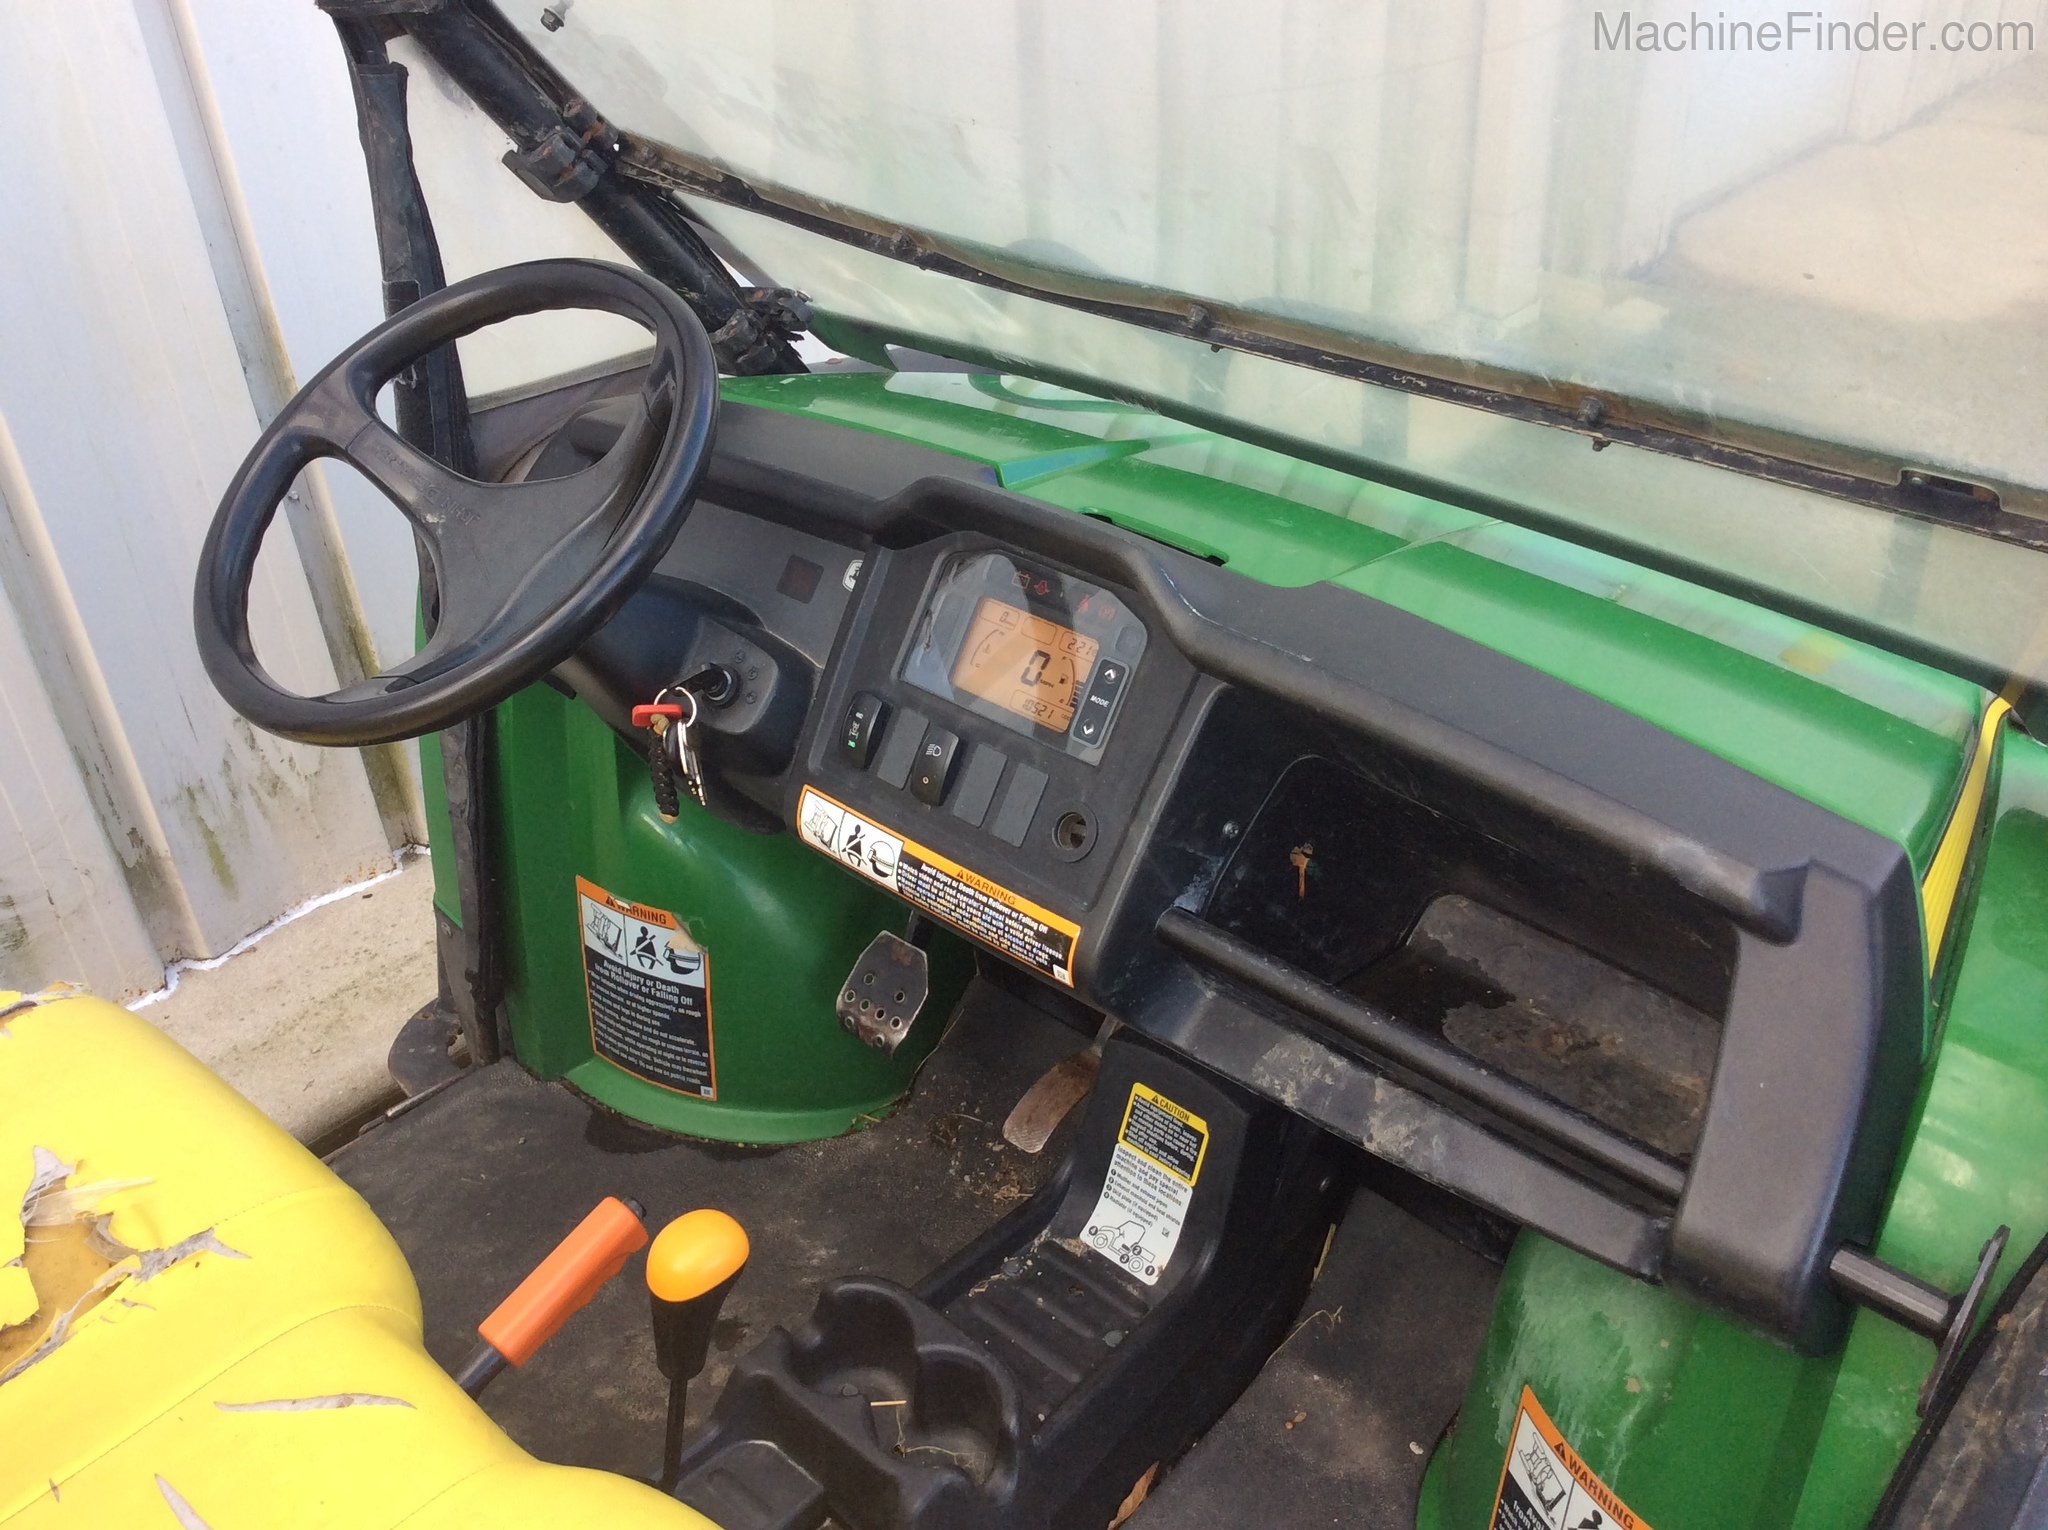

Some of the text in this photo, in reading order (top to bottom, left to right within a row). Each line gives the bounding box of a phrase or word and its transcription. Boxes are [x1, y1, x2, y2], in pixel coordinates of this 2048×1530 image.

[1020, 648, 1050, 687] 0
[1022, 698, 1054, 719] 10521
[1090, 694, 1110, 708] MODE
[966, 875, 1017, 906] WARNING
[617, 900, 667, 925] WARNING
[603, 959, 621, 974] Avoid
[622, 969, 644, 984] Injury
[655, 980, 679, 994] Death
[610, 971, 639, 989] Rollover
[640, 983, 649, 993] or
[650, 984, 678, 1003] Falling
[680, 995, 692, 1005] Off
[1160, 1099, 1190, 1122] CAUTION
[1113, 1160, 1136, 1176] attention
[1136, 1173, 1142, 1181] to
[1142, 1177, 1157, 1190] these
[1115, 1153, 1178, 1195] machine and pay special
[1117, 1145, 1136, 1160] Inspect
[1136, 1158, 1147, 1167] and
[1147, 1164, 1162, 1176] clean
[1162, 1173, 1171, 1182] the
[1171, 1180, 1187, 1193] entire
[1569, 1455, 1635, 1529] WARNING
